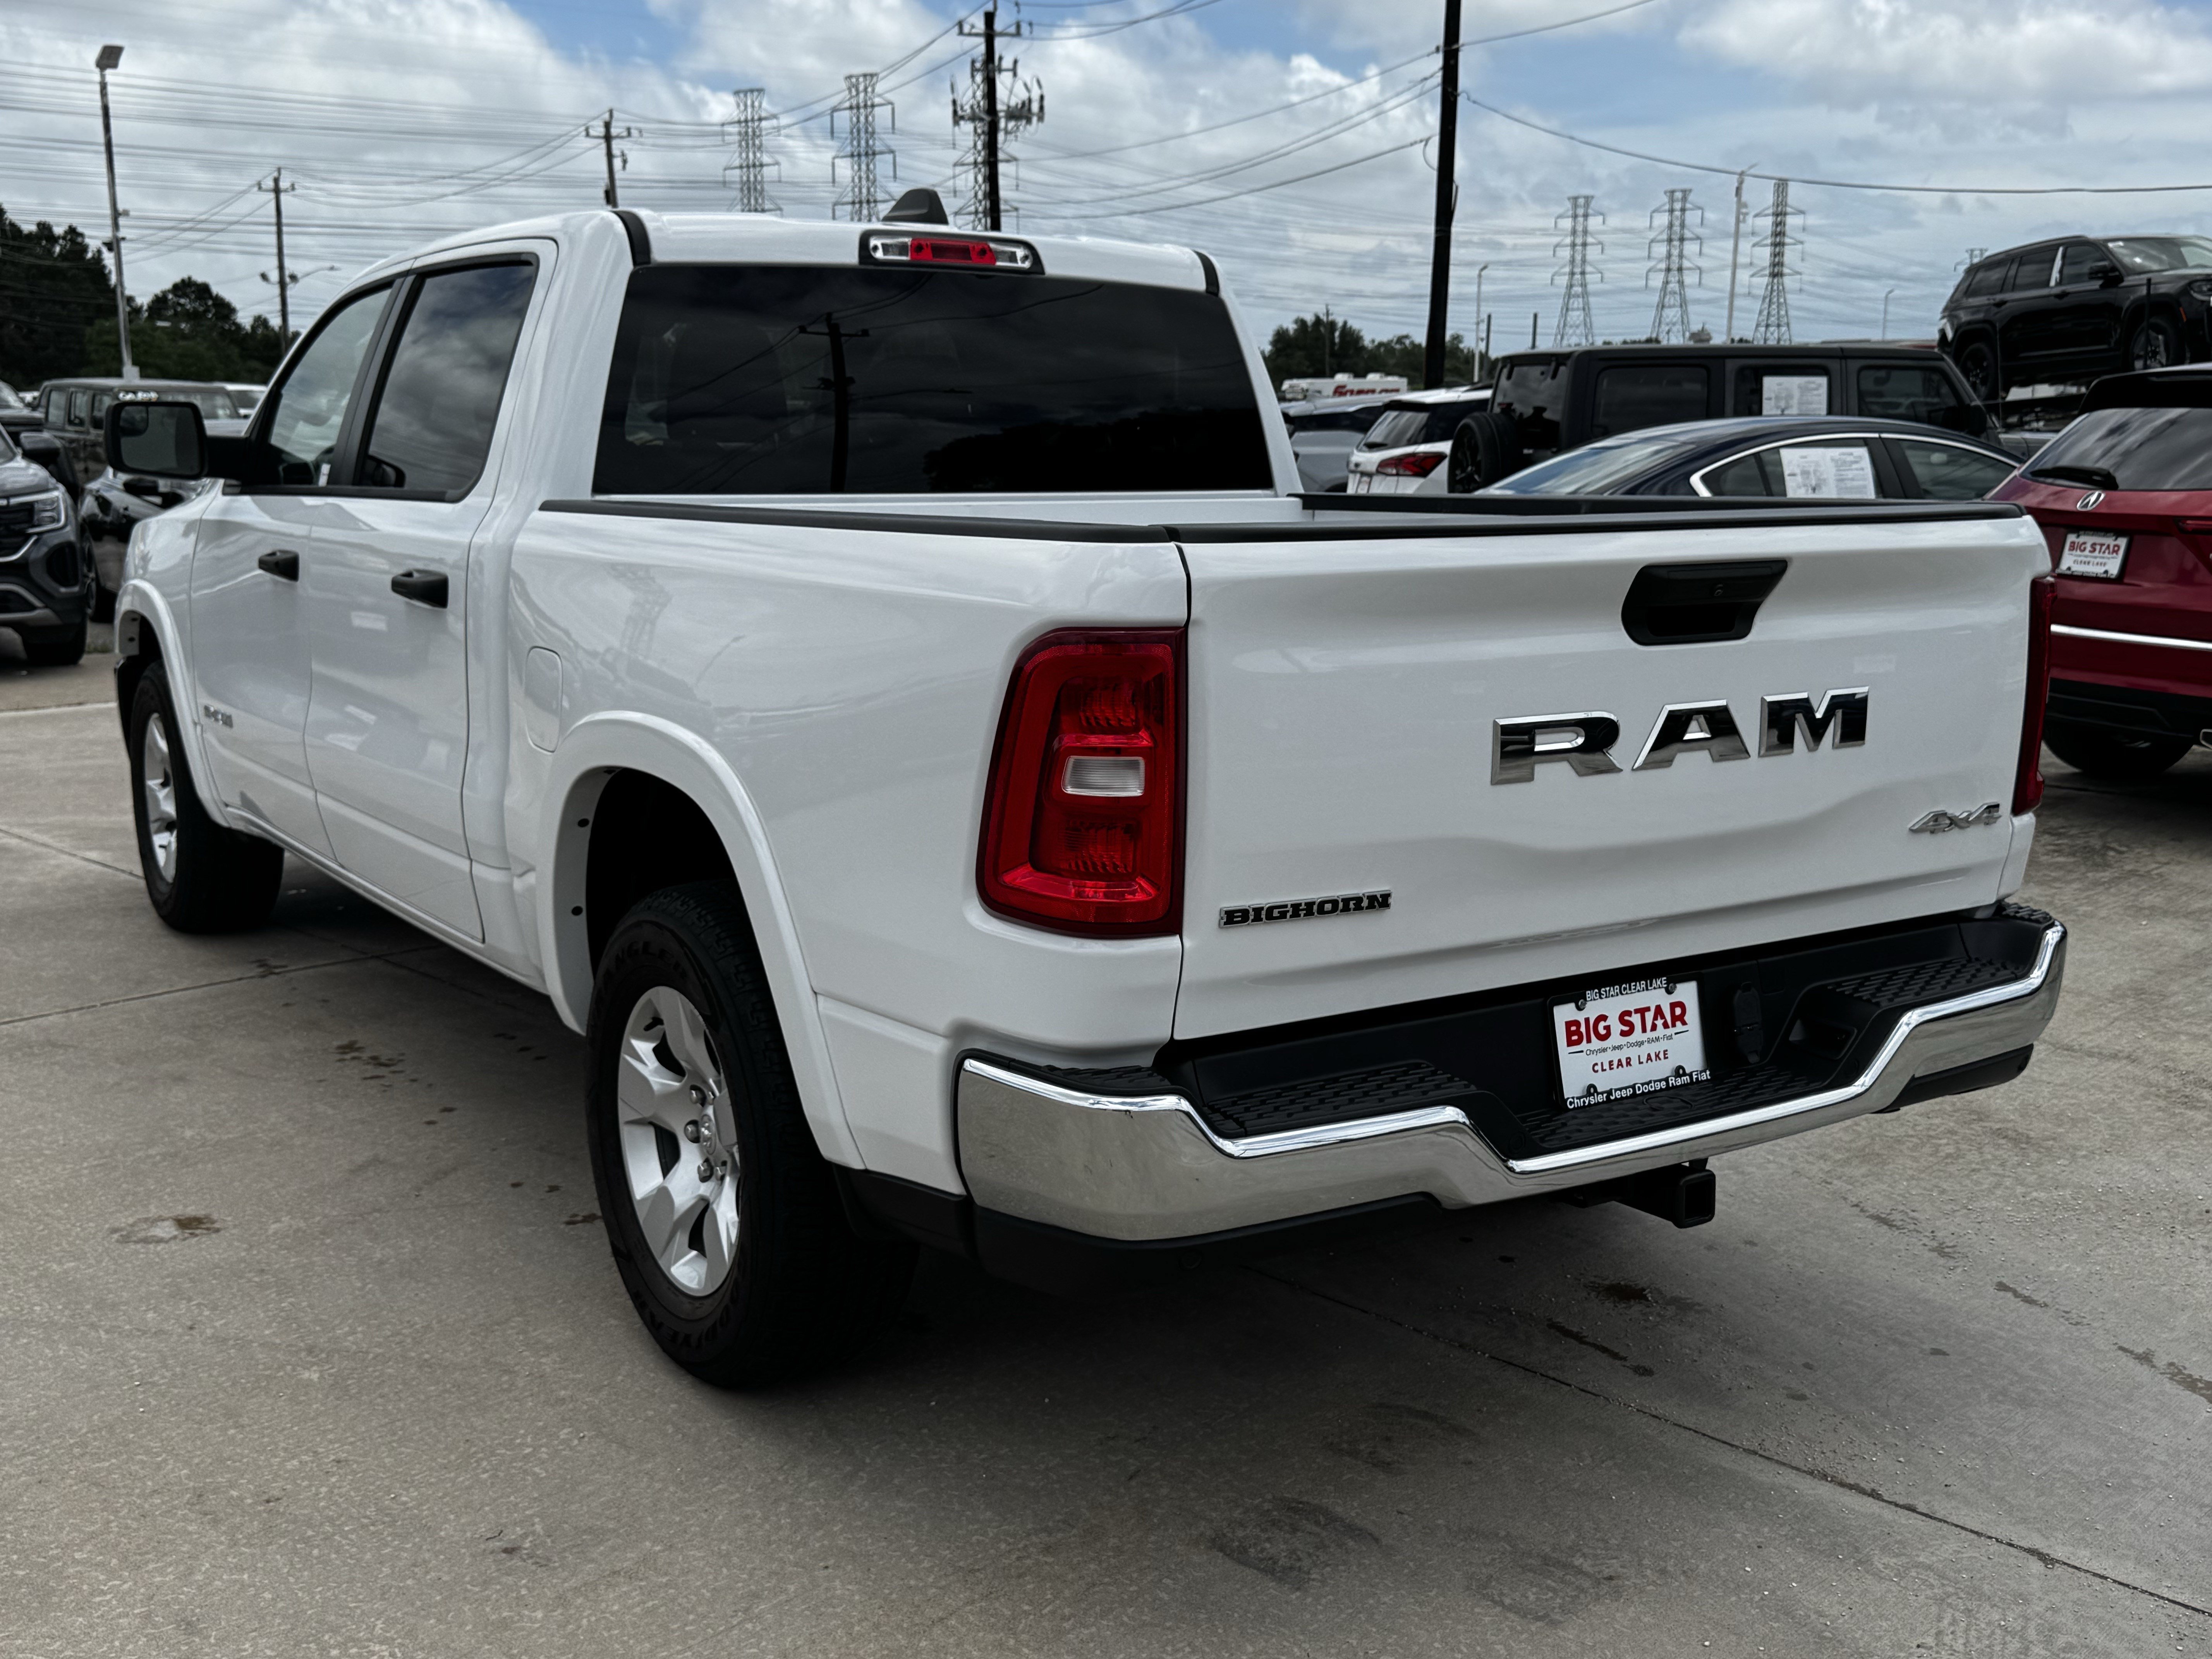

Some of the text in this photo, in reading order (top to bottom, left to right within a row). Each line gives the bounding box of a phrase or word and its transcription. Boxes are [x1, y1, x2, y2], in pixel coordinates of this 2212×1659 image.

[2068, 541, 2120, 555] BIG STAR
[1491, 686, 1869, 785] RAM
[1218, 890, 1392, 928] BIGHORN
[1586, 977, 1667, 1001] BIG STAR CLEAR LAKE
[1565, 1001, 1688, 1048] BIG STAR
[1592, 1049, 1669, 1073] CLEAR LAKE
[1567, 1069, 1711, 1108] Chrysler Jeep Dodge Ram Fiat
